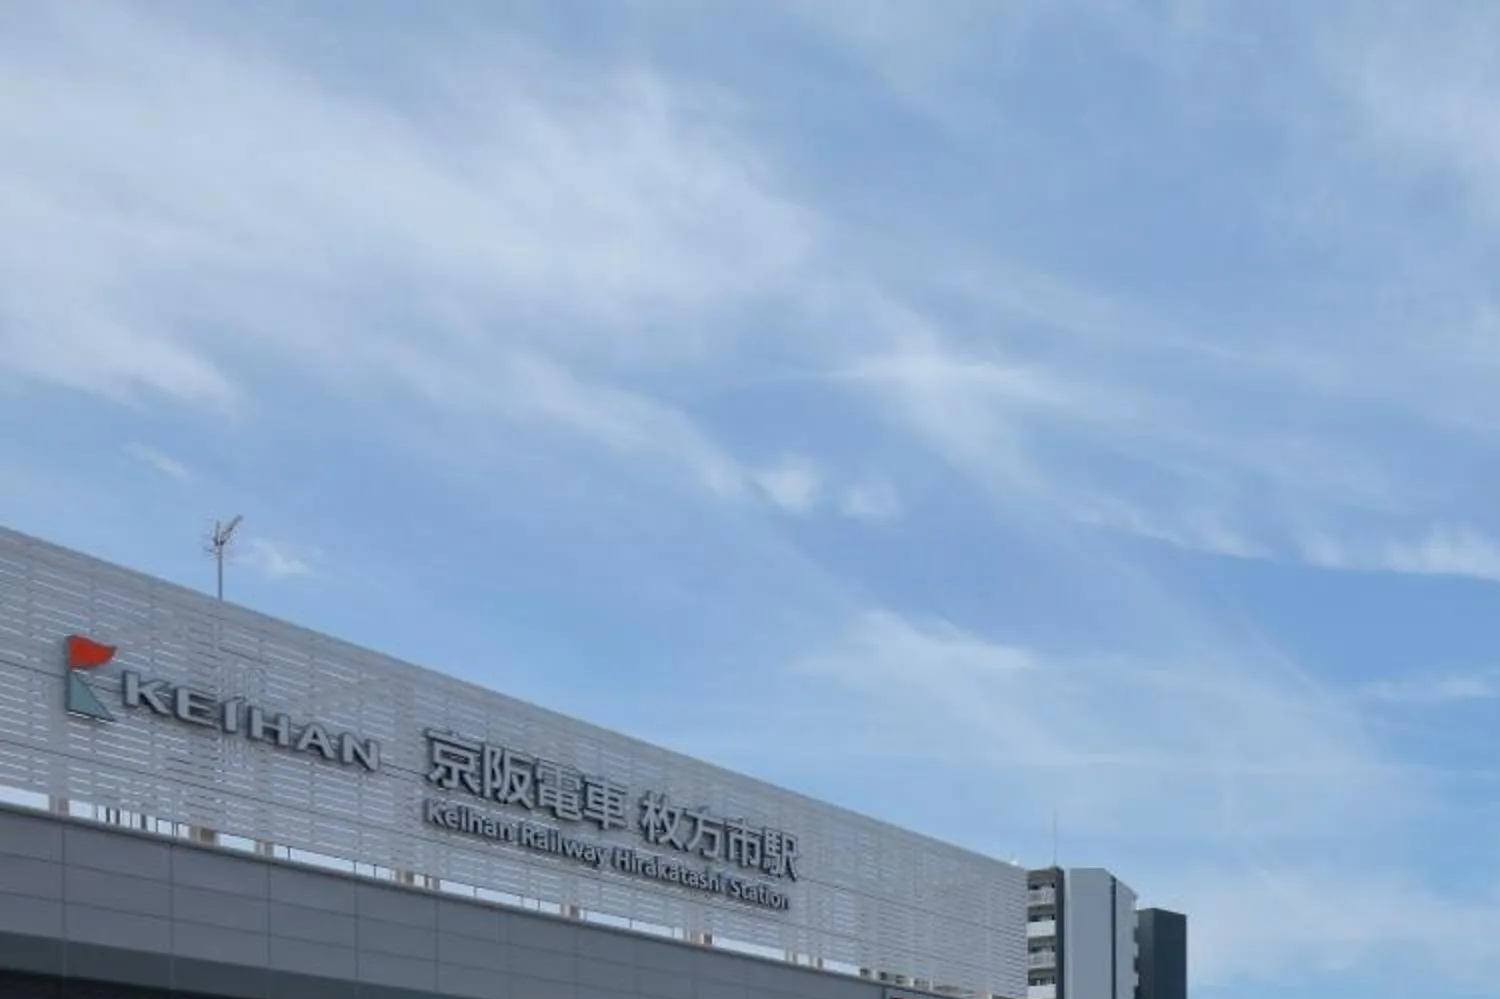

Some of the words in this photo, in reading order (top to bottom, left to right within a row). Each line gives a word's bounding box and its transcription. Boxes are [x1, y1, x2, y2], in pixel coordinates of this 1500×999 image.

[120, 669, 381, 772] KEIHAN
[424, 727, 628, 830] 京阪電車
[640, 789, 800, 882] 枚方市駅
[424, 798, 516, 841] Keihan
[518, 821, 606, 867] Railway
[612, 846, 726, 894] Hirakatashi
[730, 879, 791, 911] Station
